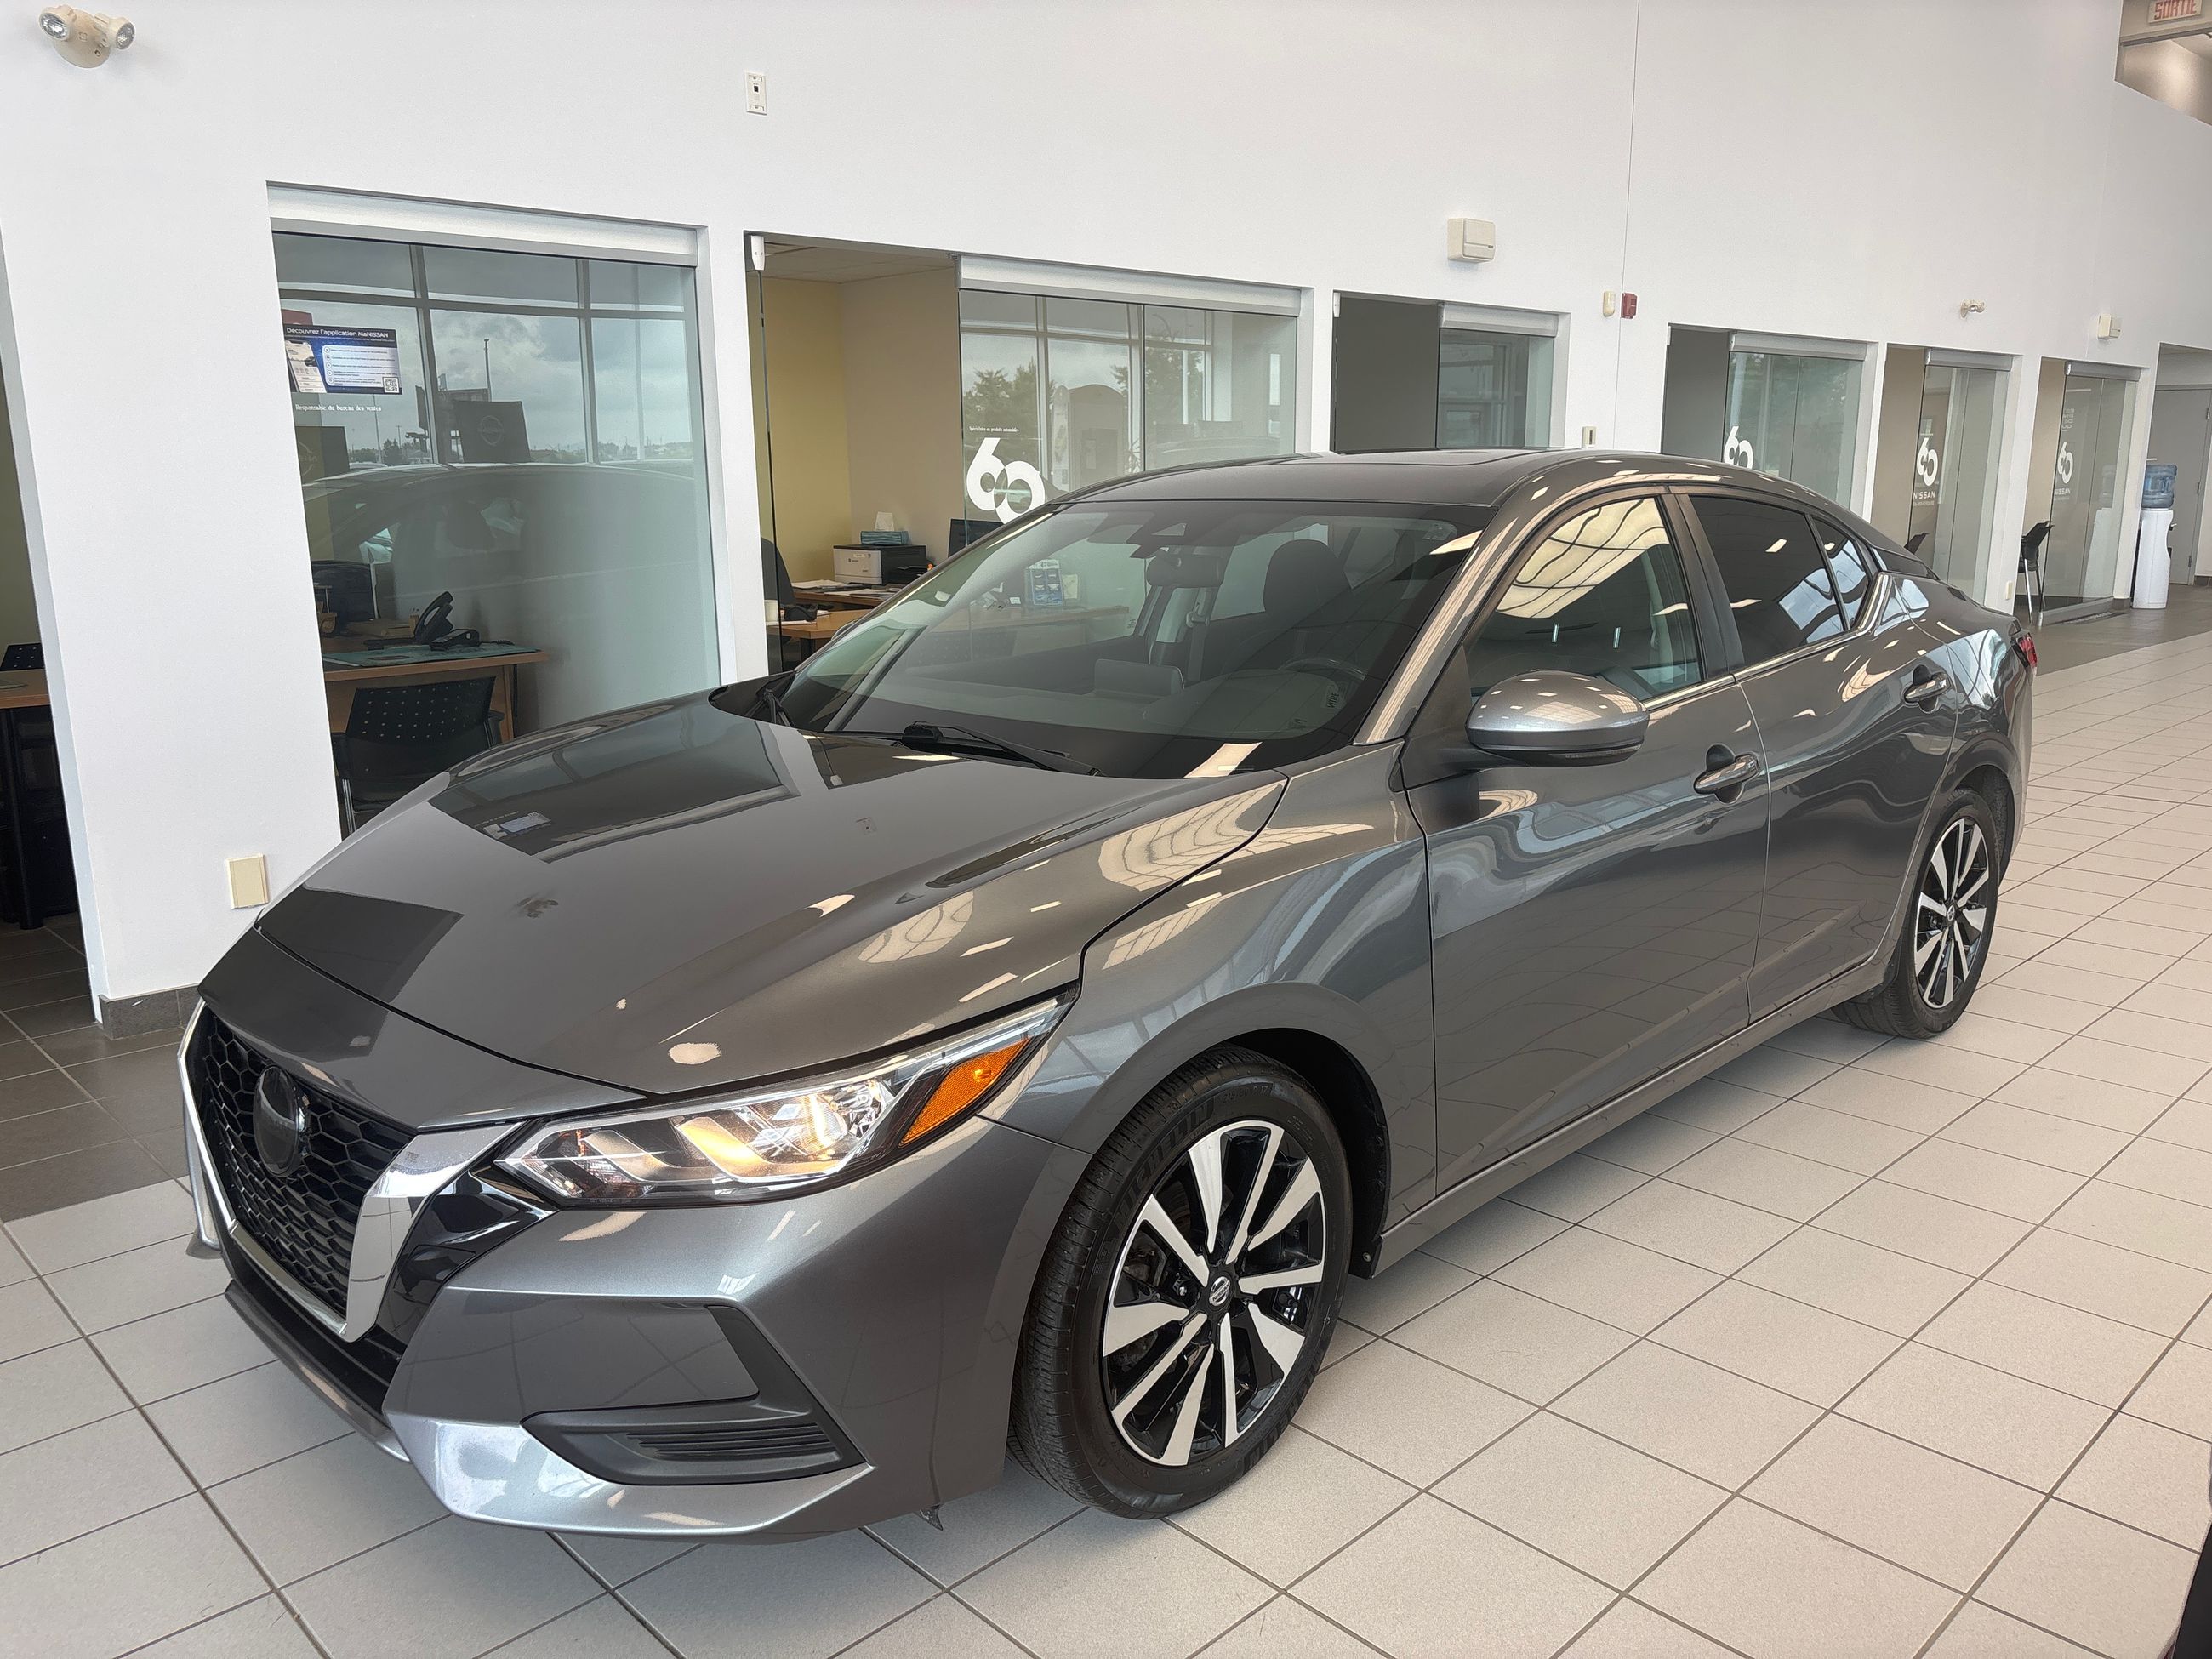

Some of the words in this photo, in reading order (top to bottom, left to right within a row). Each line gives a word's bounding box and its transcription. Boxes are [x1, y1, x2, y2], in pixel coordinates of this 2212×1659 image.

[2154, 0, 2197, 20] SORTIE
[321, 328, 357, 337] l'application
[295, 403, 327, 412] Responsable
[1724, 425, 1753, 469] 60
[1917, 437, 1938, 486] 60
[2058, 442, 2073, 483] 60
[966, 437, 1046, 524] 60
[1913, 491, 1936, 499] NISSAN
